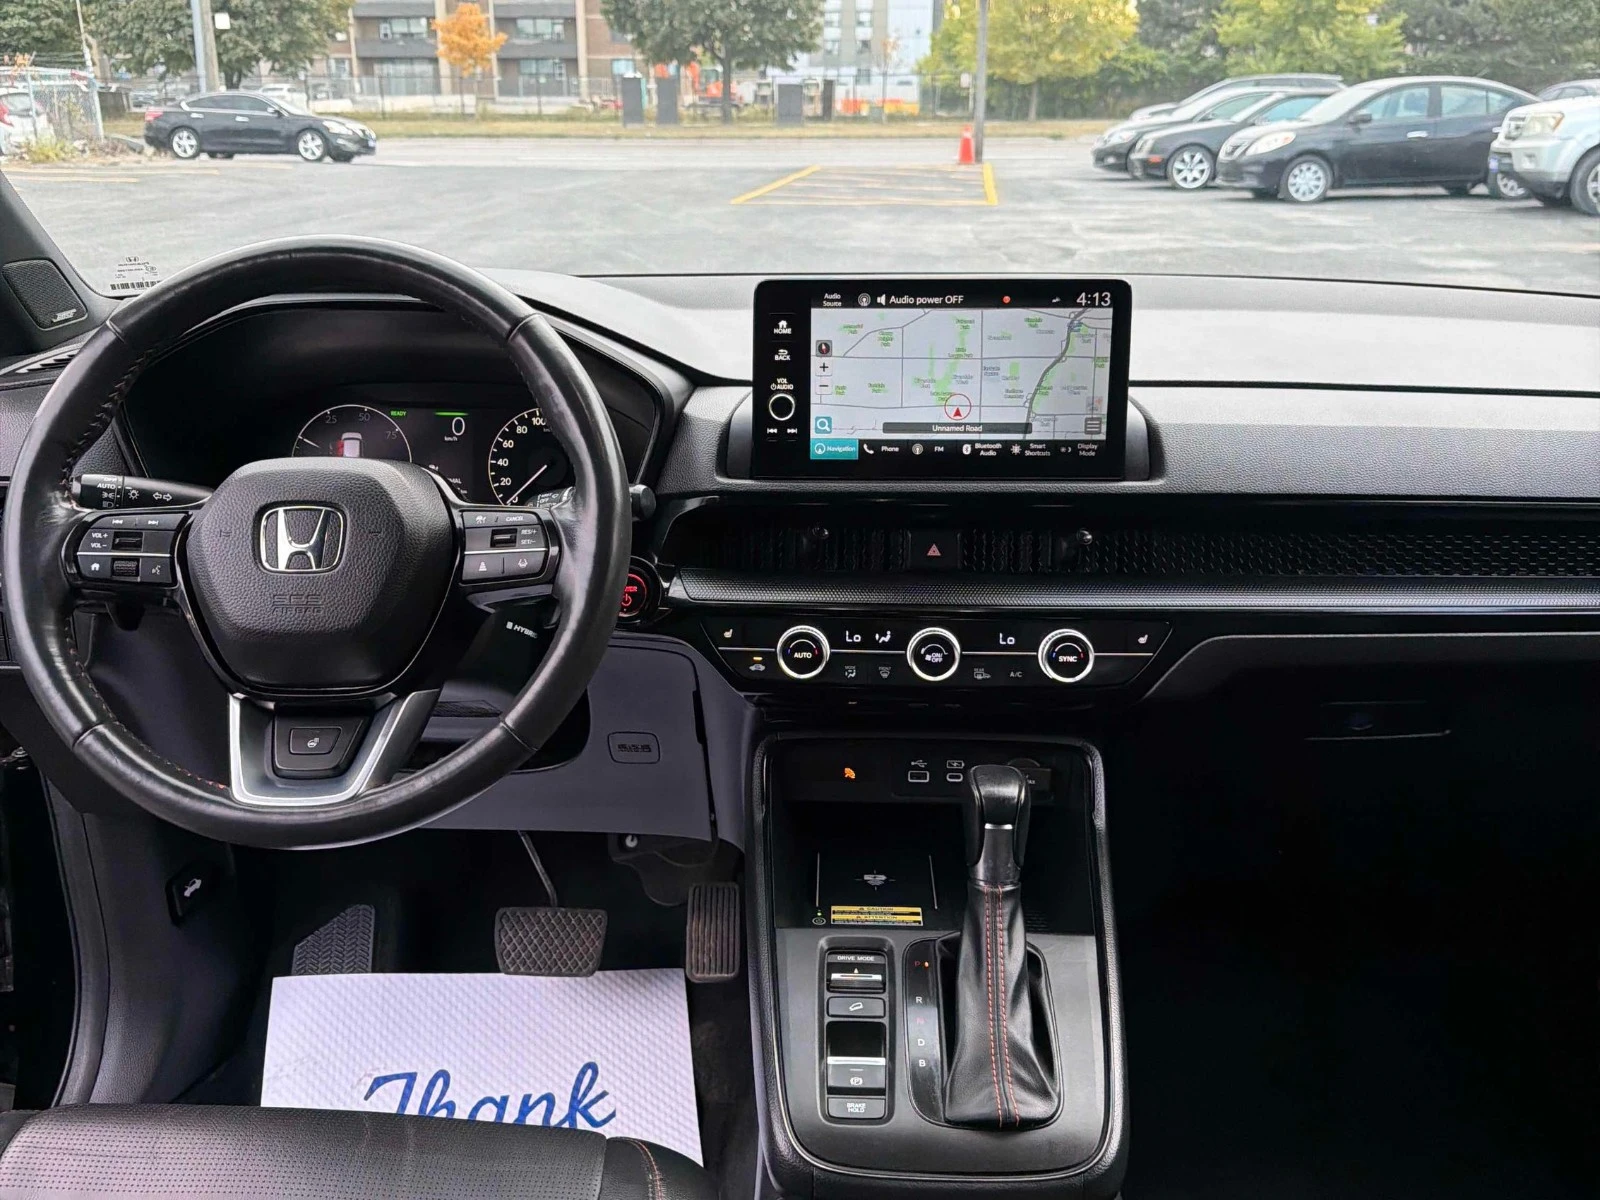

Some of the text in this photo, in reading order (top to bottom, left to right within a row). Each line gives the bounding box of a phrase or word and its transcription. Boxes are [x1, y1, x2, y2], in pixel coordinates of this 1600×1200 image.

[889, 295, 964, 306] Audio power OFF
[1076, 291, 1111, 307] 4:13
[325, 414, 337, 424] 25
[359, 412, 371, 422] 50
[451, 416, 466, 436] 0
[516, 425, 528, 434] 80
[932, 424, 983, 432] Unnamed Road
[385, 430, 397, 440] 75
[502, 439, 514, 448] 60
[1077, 443, 1098, 451] Display
[827, 445, 856, 453] Navigation
[881, 445, 900, 453] Phone
[497, 458, 509, 467] 40
[97, 482, 117, 490] AUTO
[500, 477, 512, 486] 20
[845, 630, 862, 643] Lo
[999, 632, 1016, 645] Lo
[793, 651, 813, 660] AUTO
[1058, 654, 1078, 663] SYNC
[915, 996, 923, 1004] R
[917, 1038, 925, 1046] D
[919, 1059, 926, 1067] B
[363, 1061, 617, 1129] Thank
